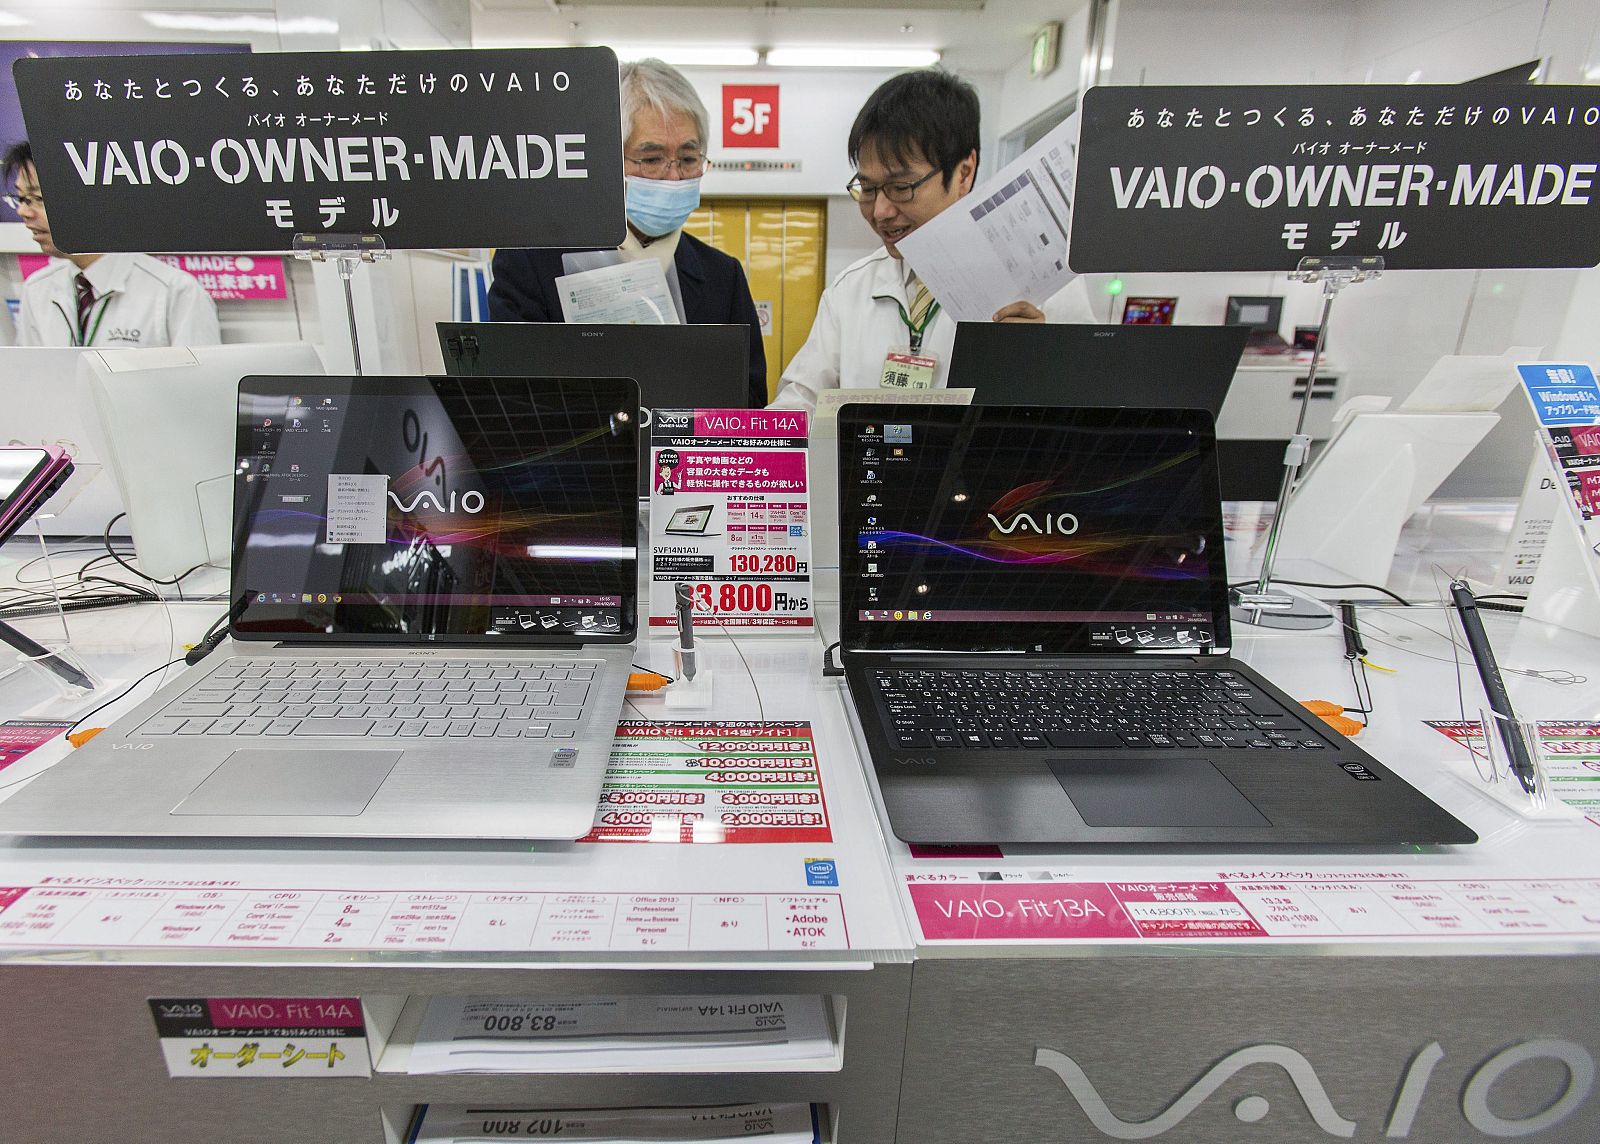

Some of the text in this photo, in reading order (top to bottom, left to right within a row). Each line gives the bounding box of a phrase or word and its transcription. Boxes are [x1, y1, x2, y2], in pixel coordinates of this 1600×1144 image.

[65, 71, 571, 101] あなたとつくる、あなただけのVAIO
[247, 111, 389, 127] バイオ オーナーメード
[731, 98, 771, 135] 5F
[1293, 140, 1428, 156] バイオ オーナーメード
[265, 197, 399, 228] モデル
[1281, 220, 1408, 250] モデル
[884, 371, 909, 387] 須藤
[659, 416, 688, 424] VAIO
[751, 417, 768, 430] Fit
[773, 417, 799, 430] 14A
[671, 438, 791, 447] VAIOオーナーメードでお好みの仕様に
[687, 456, 753, 465] 写真や動画などの
[687, 468, 769, 476] 容量の大きなデータも
[687, 480, 804, 488] 軽快に操作できるものが欲しい
[388, 490, 485, 513] VAIO
[987, 512, 1079, 535] VAIO
[728, 554, 808, 573] 130,280円
[1508, 576, 1535, 585] VAIO
[699, 742, 810, 751] 12,000円引き!
[699, 758, 813, 768] 10,000円引き!
[705, 771, 815, 782] 4,000円引き!
[608, 792, 705, 804] 5,000円引き!
[722, 793, 819, 805] 3,000円引き!
[721, 813, 822, 826] 2,000円引き!
[905, 874, 969, 882] 選べるカラー
[1117, 884, 1219, 892] VAIOオーナーメード
[1153, 892, 1199, 901] 販売価格
[1018, 899, 1053, 918] Fit
[1053, 898, 1105, 918] 13A
[1220, 908, 1242, 916] から
[720, 920, 738, 928] あり
[160, 1004, 202, 1013] VAIO
[286, 1004, 311, 1019] Fit
[315, 1004, 353, 1019] 14A
[698, 1002, 783, 1016] VAIO Fit 14A
[484, 1015, 556, 1031] 83,800
[755, 1018, 786, 1026] VAIO
[191, 1043, 345, 1068] オーダーシート
[1035, 1038, 1596, 1141] VAIO
[483, 1119, 563, 1134] 102800
